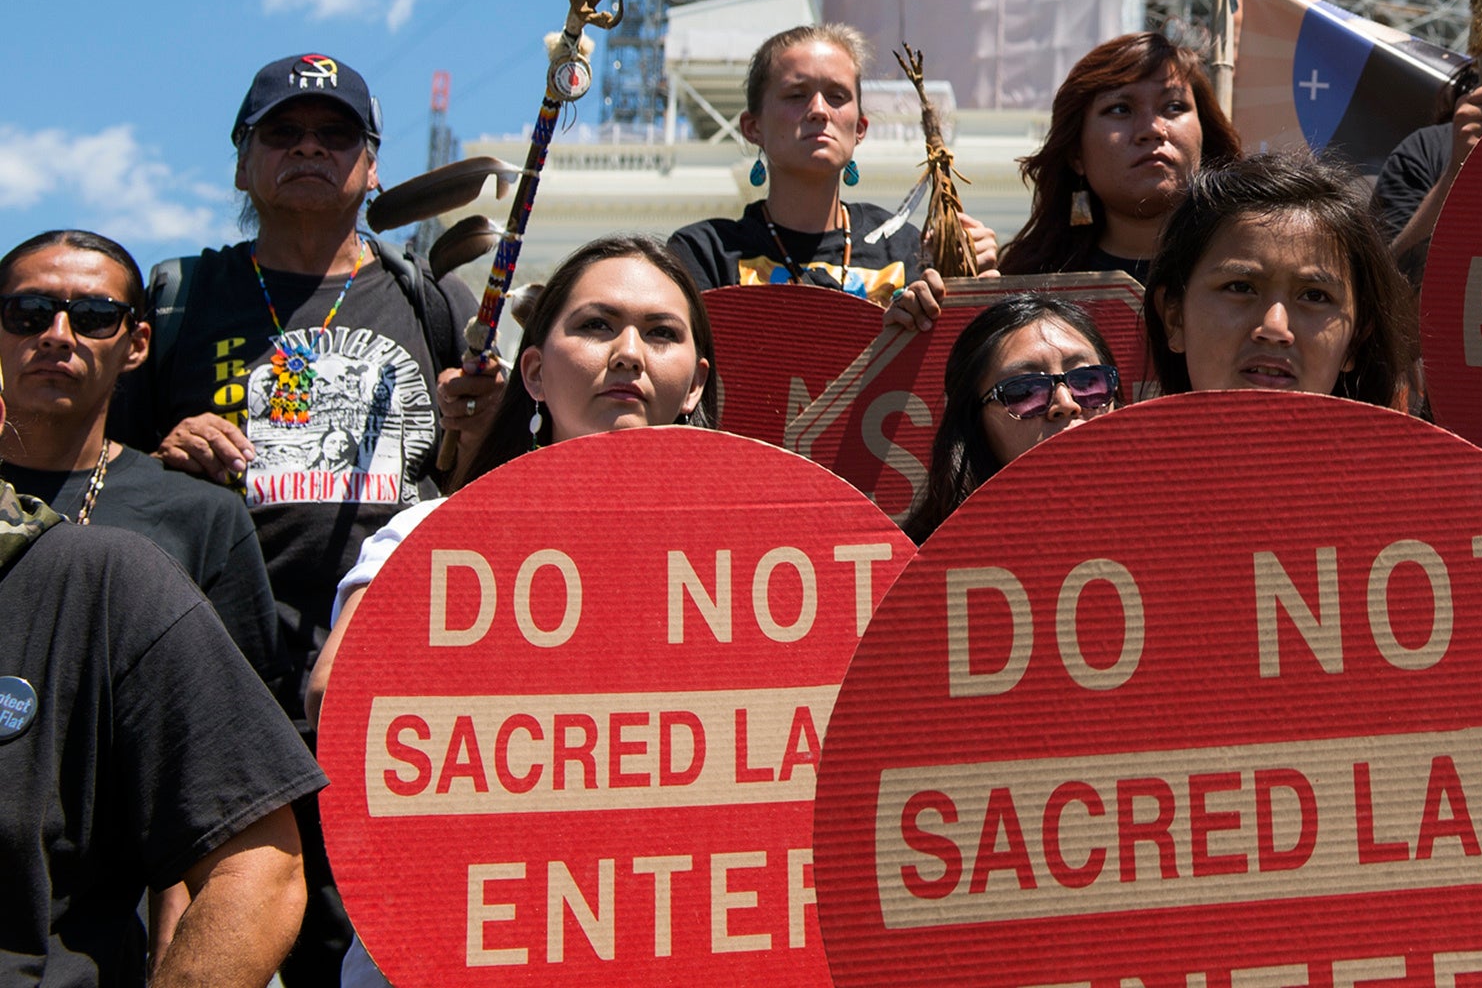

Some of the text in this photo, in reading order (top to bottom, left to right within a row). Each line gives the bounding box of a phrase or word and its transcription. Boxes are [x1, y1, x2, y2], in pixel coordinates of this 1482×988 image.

[267, 325, 432, 408] INDIGENOUS
[253, 471, 399, 505] SACRED SITES
[428, 543, 893, 648] DO NOT
[944, 558, 1146, 698] DO
[0, 693, 31, 713] otect
[0, 710, 25, 731] Flat
[382, 704, 826, 797] SACRED LA
[900, 767, 1320, 901] SACRED
